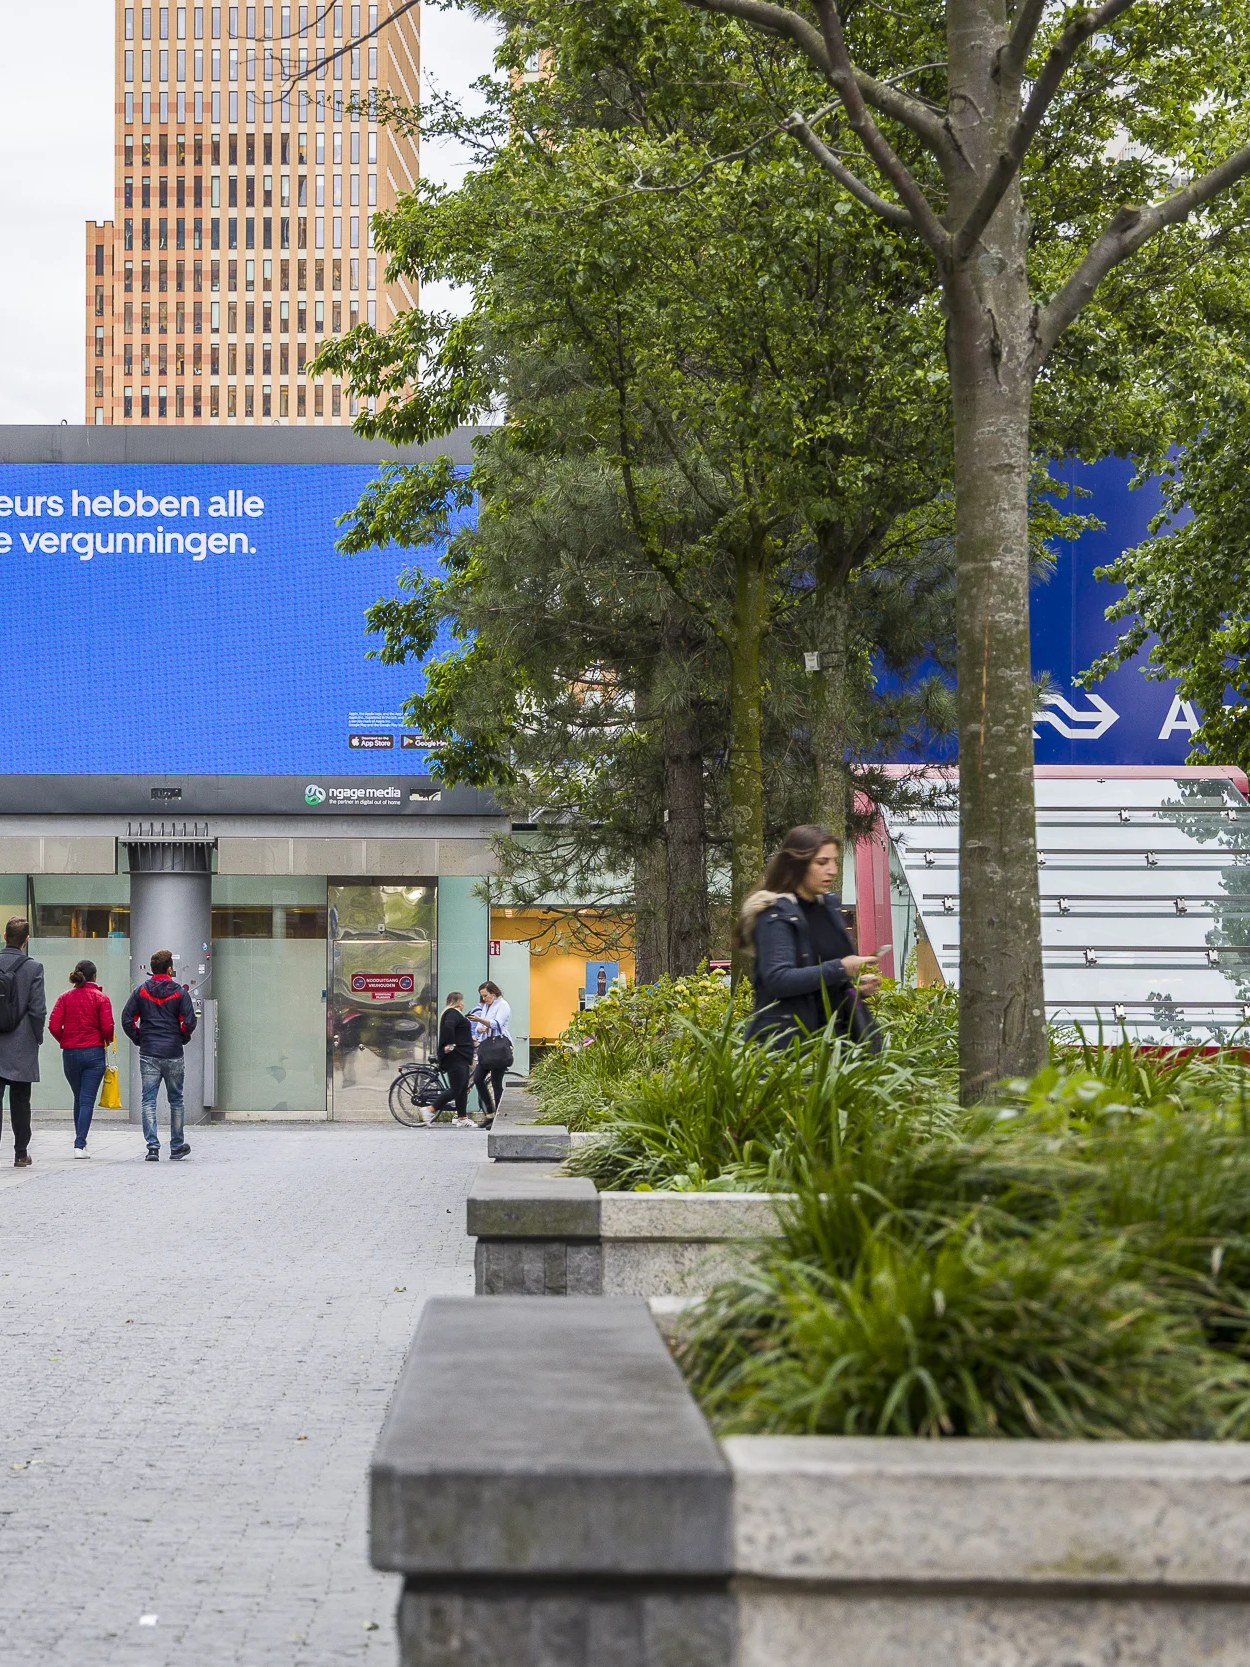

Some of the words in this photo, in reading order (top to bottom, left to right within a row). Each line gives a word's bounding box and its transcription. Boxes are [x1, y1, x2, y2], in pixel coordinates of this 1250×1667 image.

[71, 489, 200, 517] hebben
[207, 489, 265, 517] alle
[19, 525, 257, 561] vergunningen.
[329, 788, 365, 800] ngage
[365, 786, 401, 798] media
